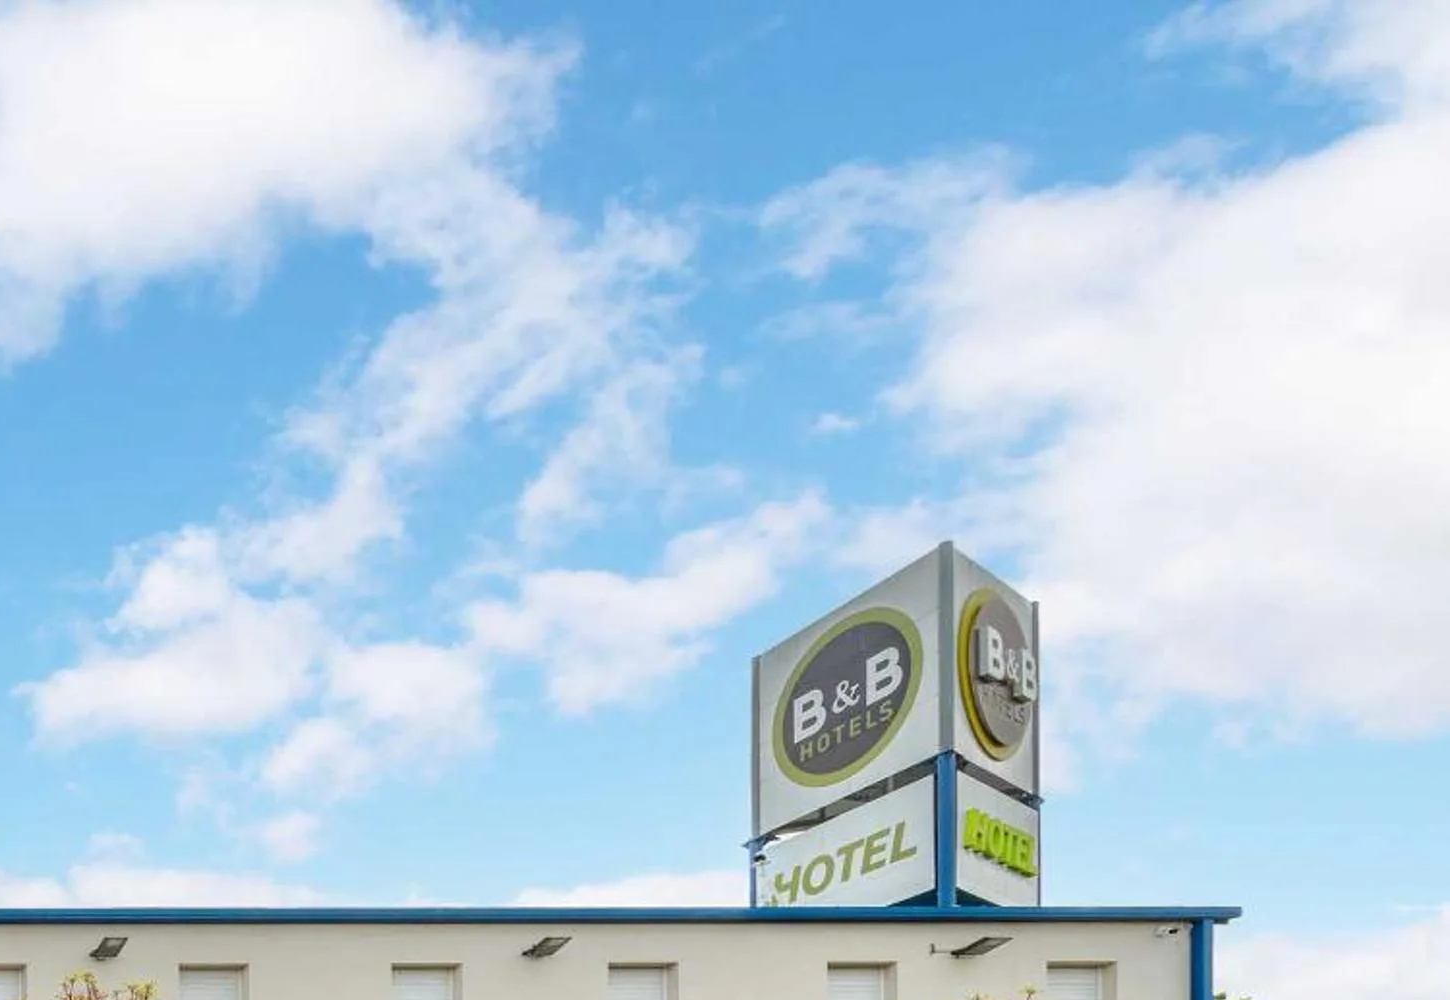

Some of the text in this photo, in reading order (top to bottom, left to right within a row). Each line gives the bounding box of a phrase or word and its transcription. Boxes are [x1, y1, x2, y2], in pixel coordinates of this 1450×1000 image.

[793, 647, 903, 744] B&B
[978, 623, 1037, 702] B&B
[799, 701, 894, 763] HOTELS
